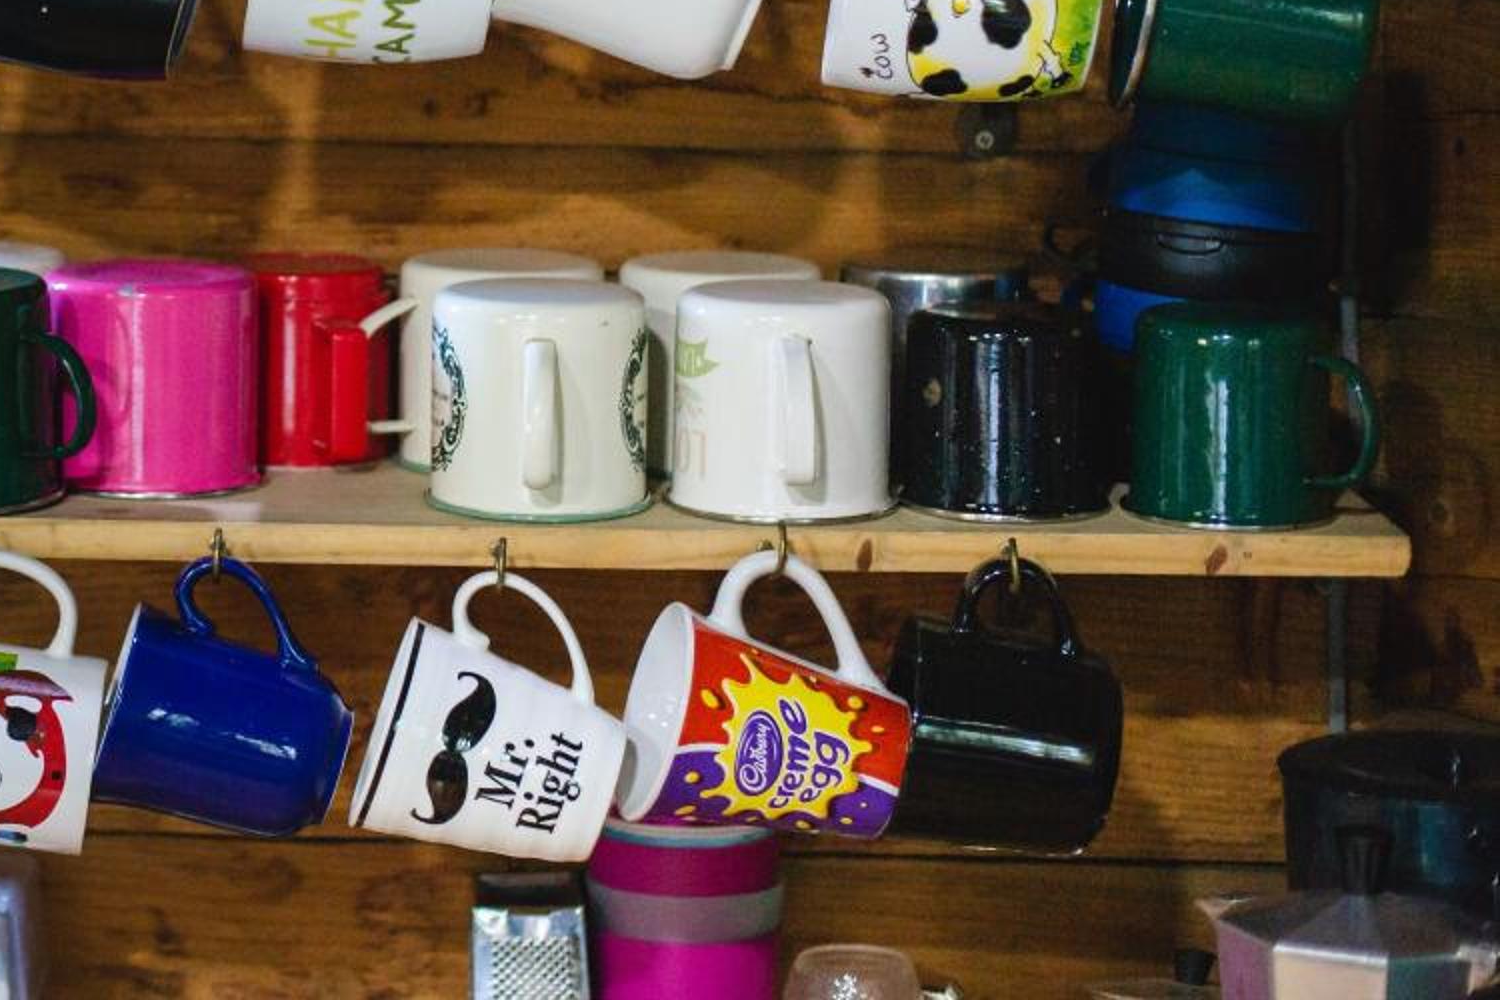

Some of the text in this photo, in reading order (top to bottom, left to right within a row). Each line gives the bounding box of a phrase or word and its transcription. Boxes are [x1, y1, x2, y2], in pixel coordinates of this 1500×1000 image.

[474, 738, 536, 810] Mr.
[515, 731, 583, 835] Right
[739, 723, 771, 793] Cadbury
[768, 699, 808, 808] creme
[799, 731, 850, 802] egg
